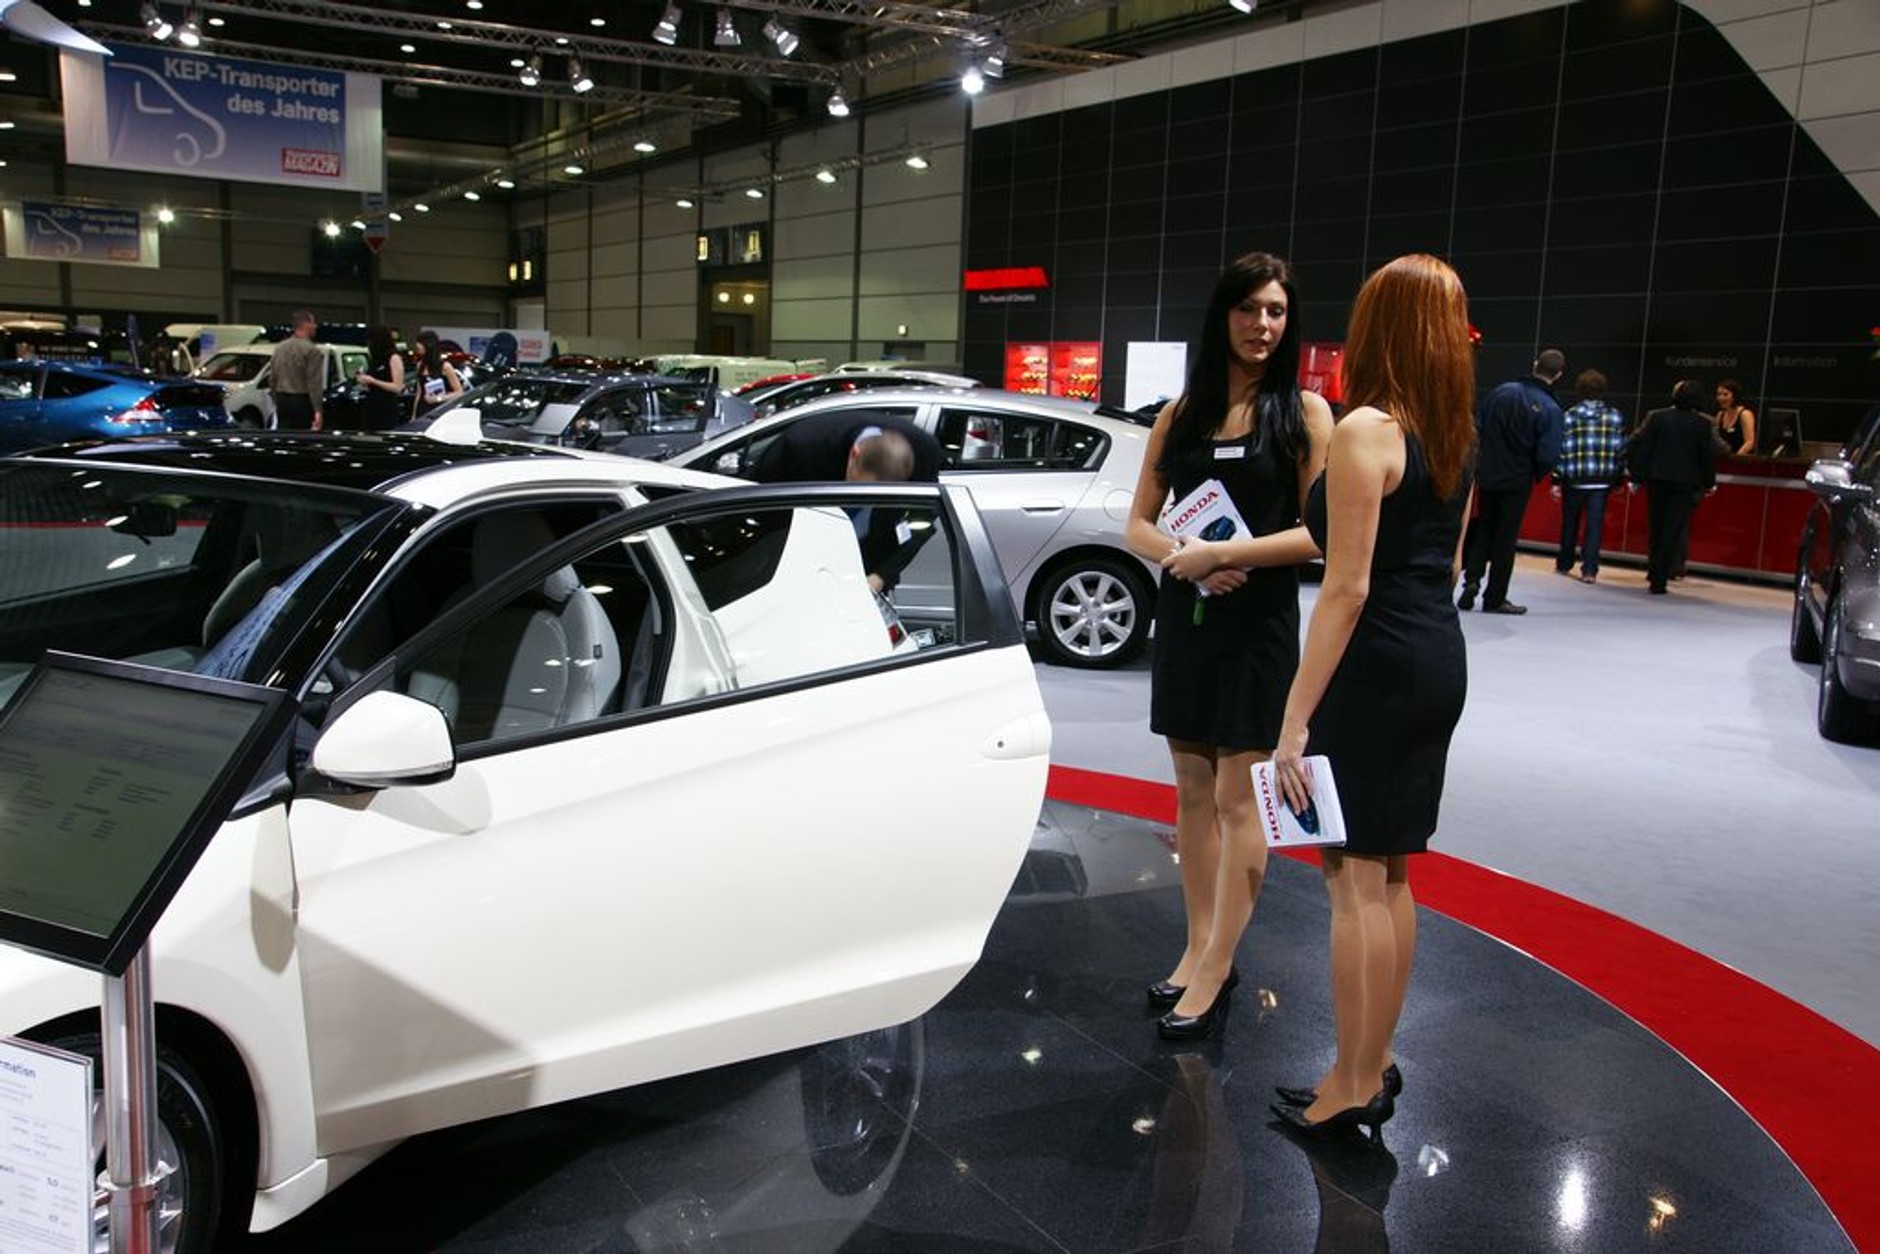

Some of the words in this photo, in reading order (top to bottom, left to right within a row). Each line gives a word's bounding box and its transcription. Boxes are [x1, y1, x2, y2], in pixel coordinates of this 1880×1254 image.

[164, 56, 340, 97] KEP-Transporter
[226, 93, 265, 115] des
[271, 98, 339, 123] Jahres
[1170, 490, 1219, 532] HONDA
[1259, 766, 1281, 841] HONDA
